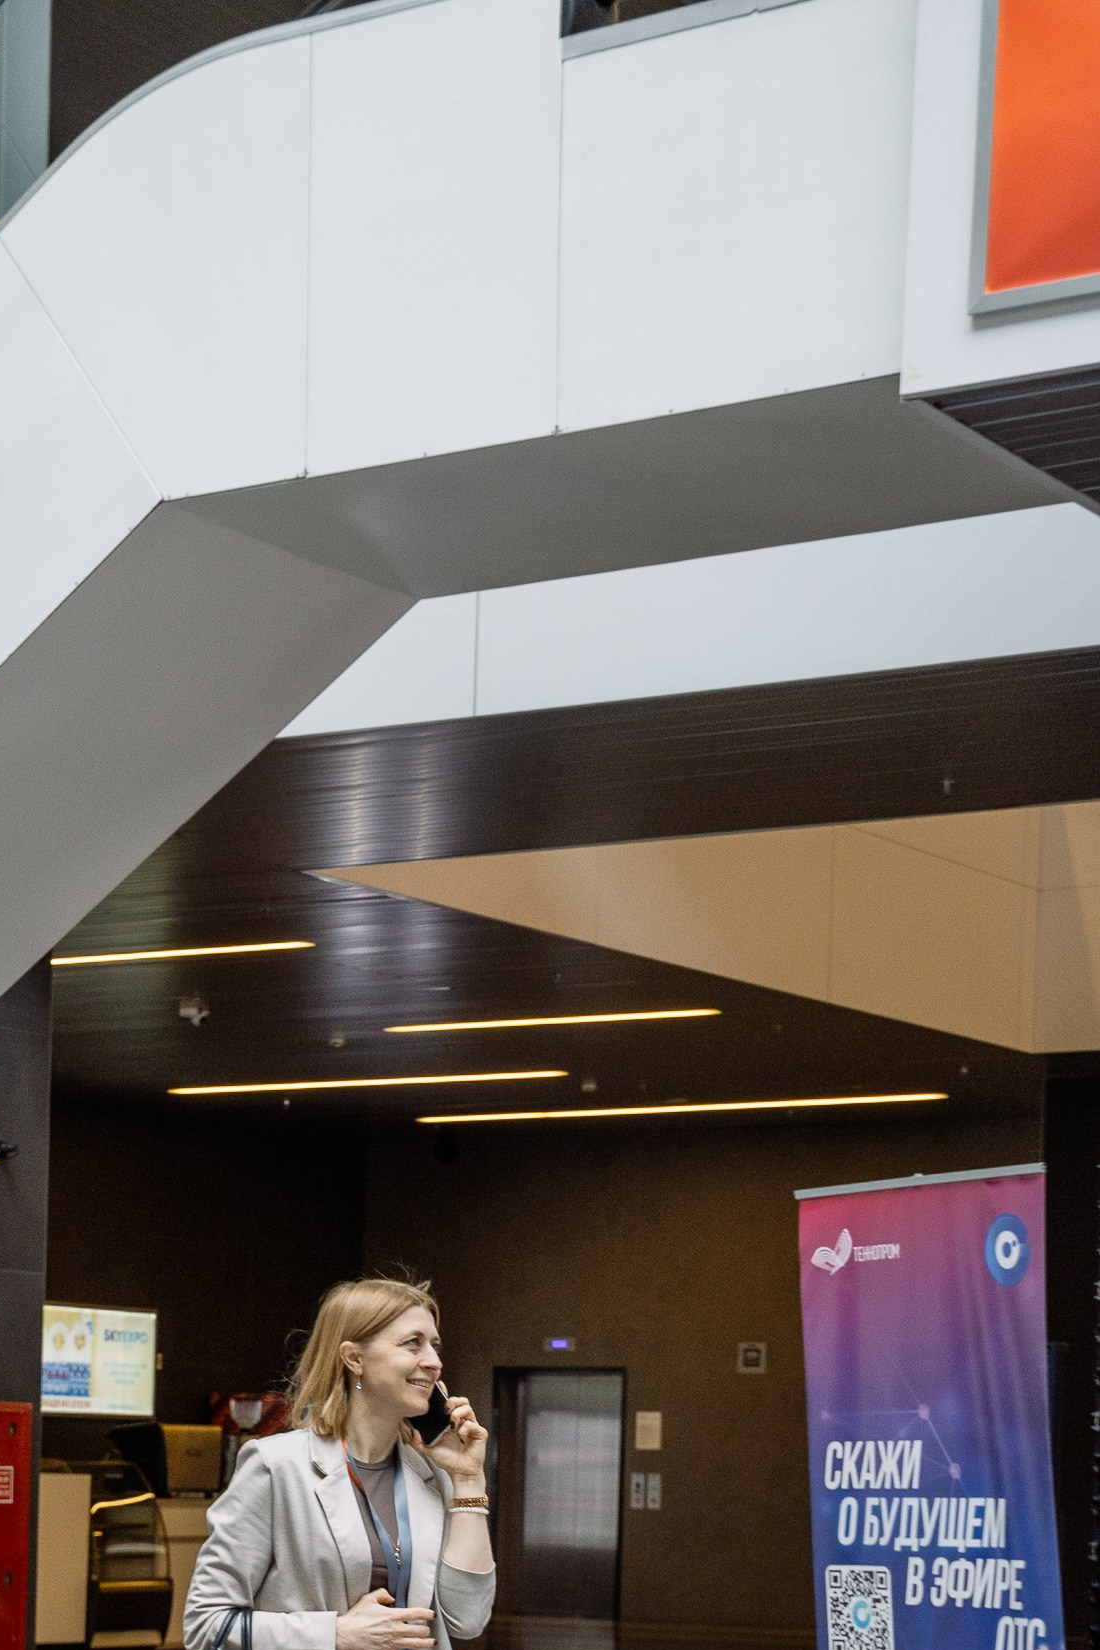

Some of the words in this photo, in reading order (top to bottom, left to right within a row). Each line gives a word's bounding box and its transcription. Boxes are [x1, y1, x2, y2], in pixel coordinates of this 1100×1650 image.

[824, 1440, 923, 1490] СКАЖИ
[837, 1497, 859, 1546] О
[863, 1497, 1006, 1553] БУДУЩЕМ
[904, 1556, 924, 1606] В
[930, 1556, 1026, 1611] ЭФИРЕ
